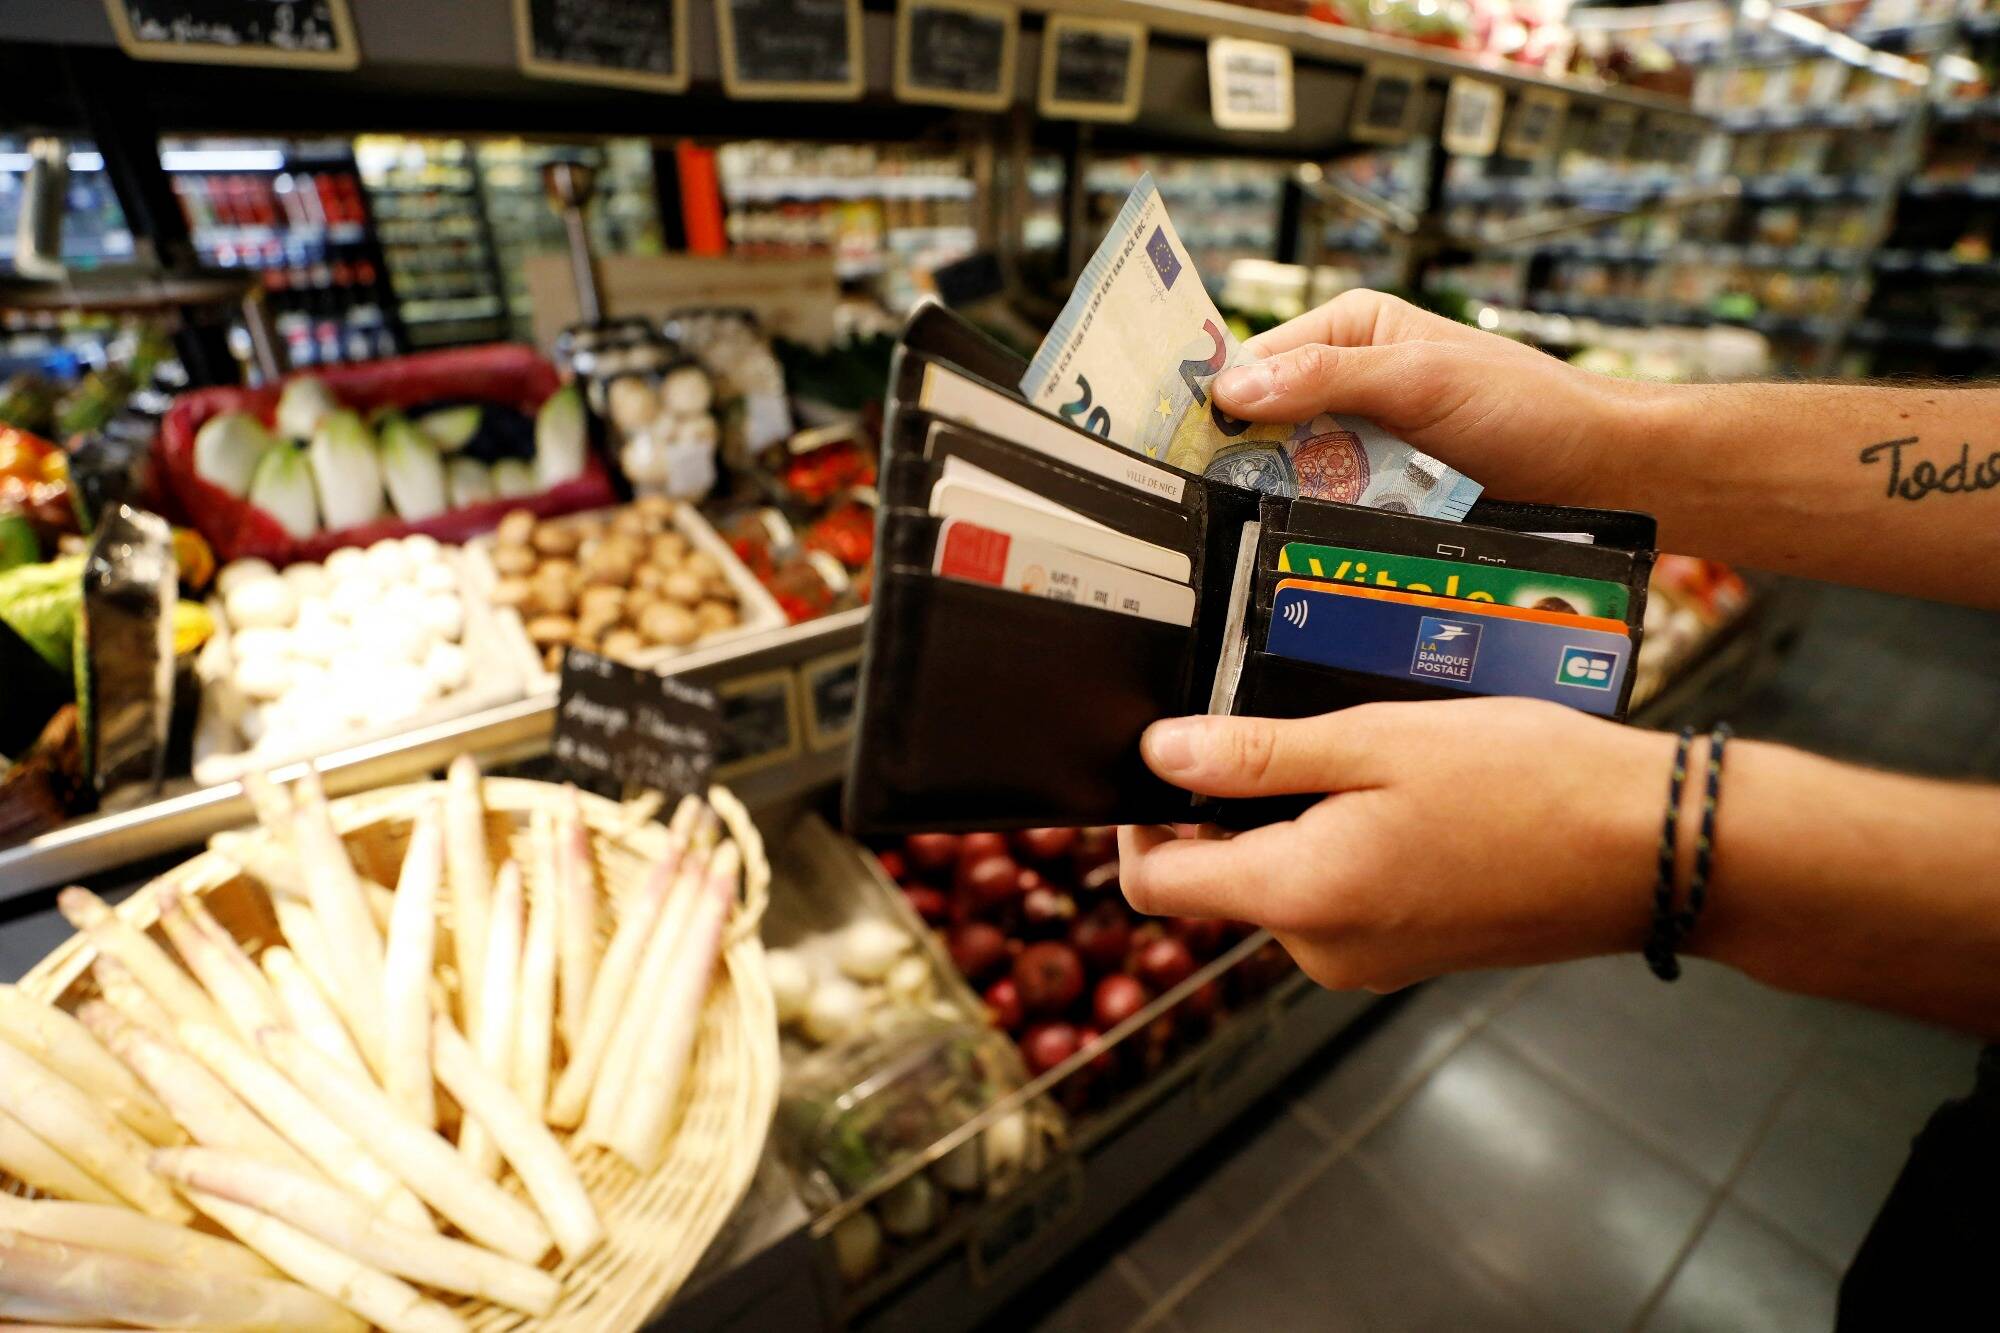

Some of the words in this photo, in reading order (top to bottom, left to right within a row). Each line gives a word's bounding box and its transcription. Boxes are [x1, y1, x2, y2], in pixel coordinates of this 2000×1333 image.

[1134, 219, 1146, 239] EBC
[1860, 436, 2000, 501] Todo
[1126, 469, 1147, 485] VILLE
[1147, 477, 1158, 489] DE
[1159, 481, 1178, 496] NICE
[1421, 641, 1437, 651] LA
[1419, 651, 1470, 667] BANQUE
[1416, 661, 1468, 677] POSTALE
